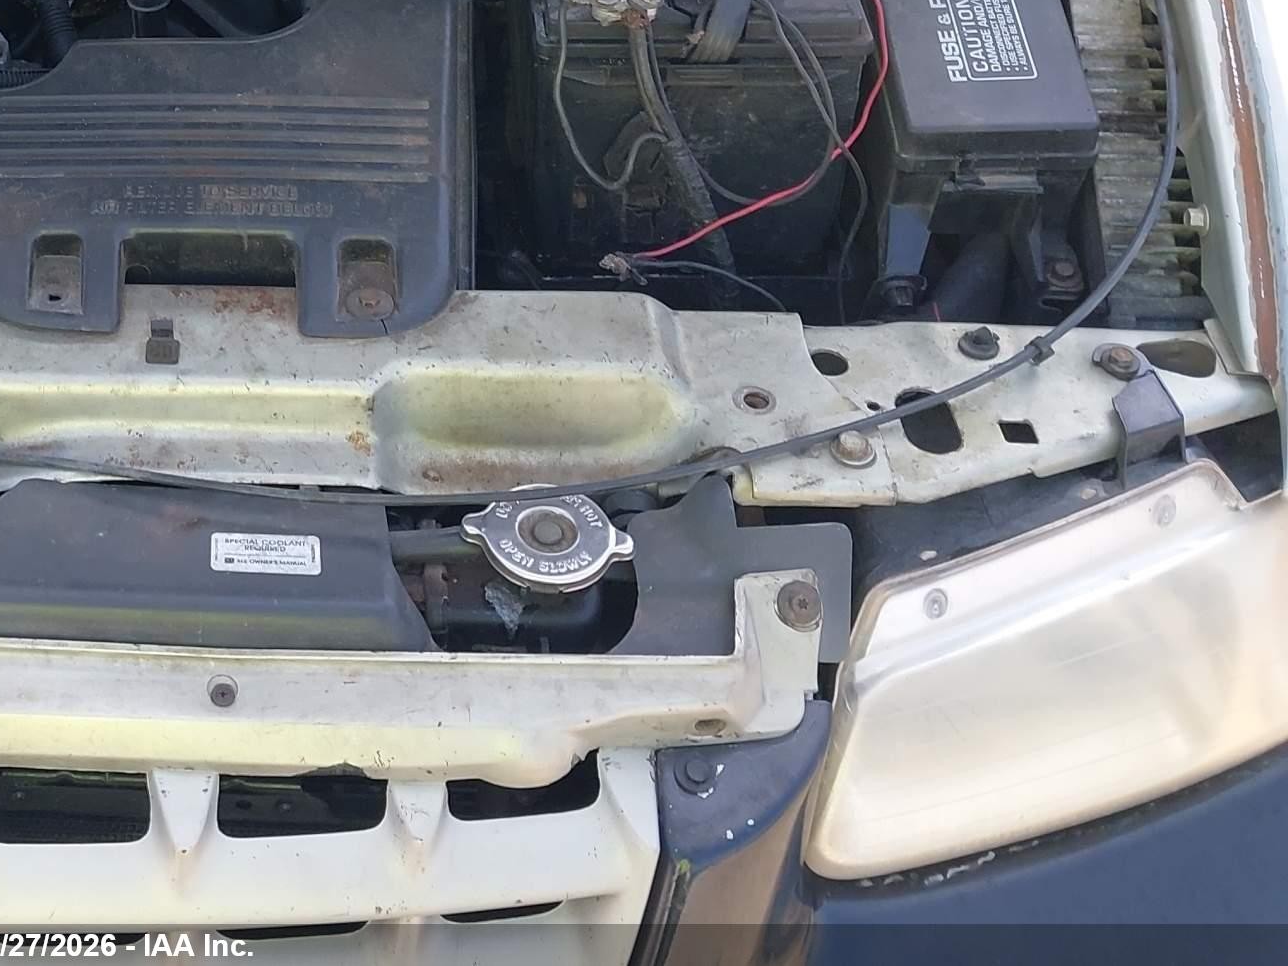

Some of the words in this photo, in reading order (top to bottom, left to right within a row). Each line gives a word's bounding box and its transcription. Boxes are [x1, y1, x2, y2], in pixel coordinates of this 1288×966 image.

[938, 14, 952, 25] &
[1003, 6, 1015, 24] SURE
[1009, 25, 1018, 34] BE
[990, 21, 1010, 66] DISCONNECT
[996, 15, 1014, 50] SPECIFIED
[938, 31, 968, 82] FUSE
[980, 30, 1002, 72] DAMAGE
[1008, 52, 1019, 66] USE
[1012, 36, 1028, 65] ALWAYS
[262, 539, 306, 547] COOLANT
[499, 539, 534, 568] OPEN
[539, 550, 592, 574] SLOWLY
